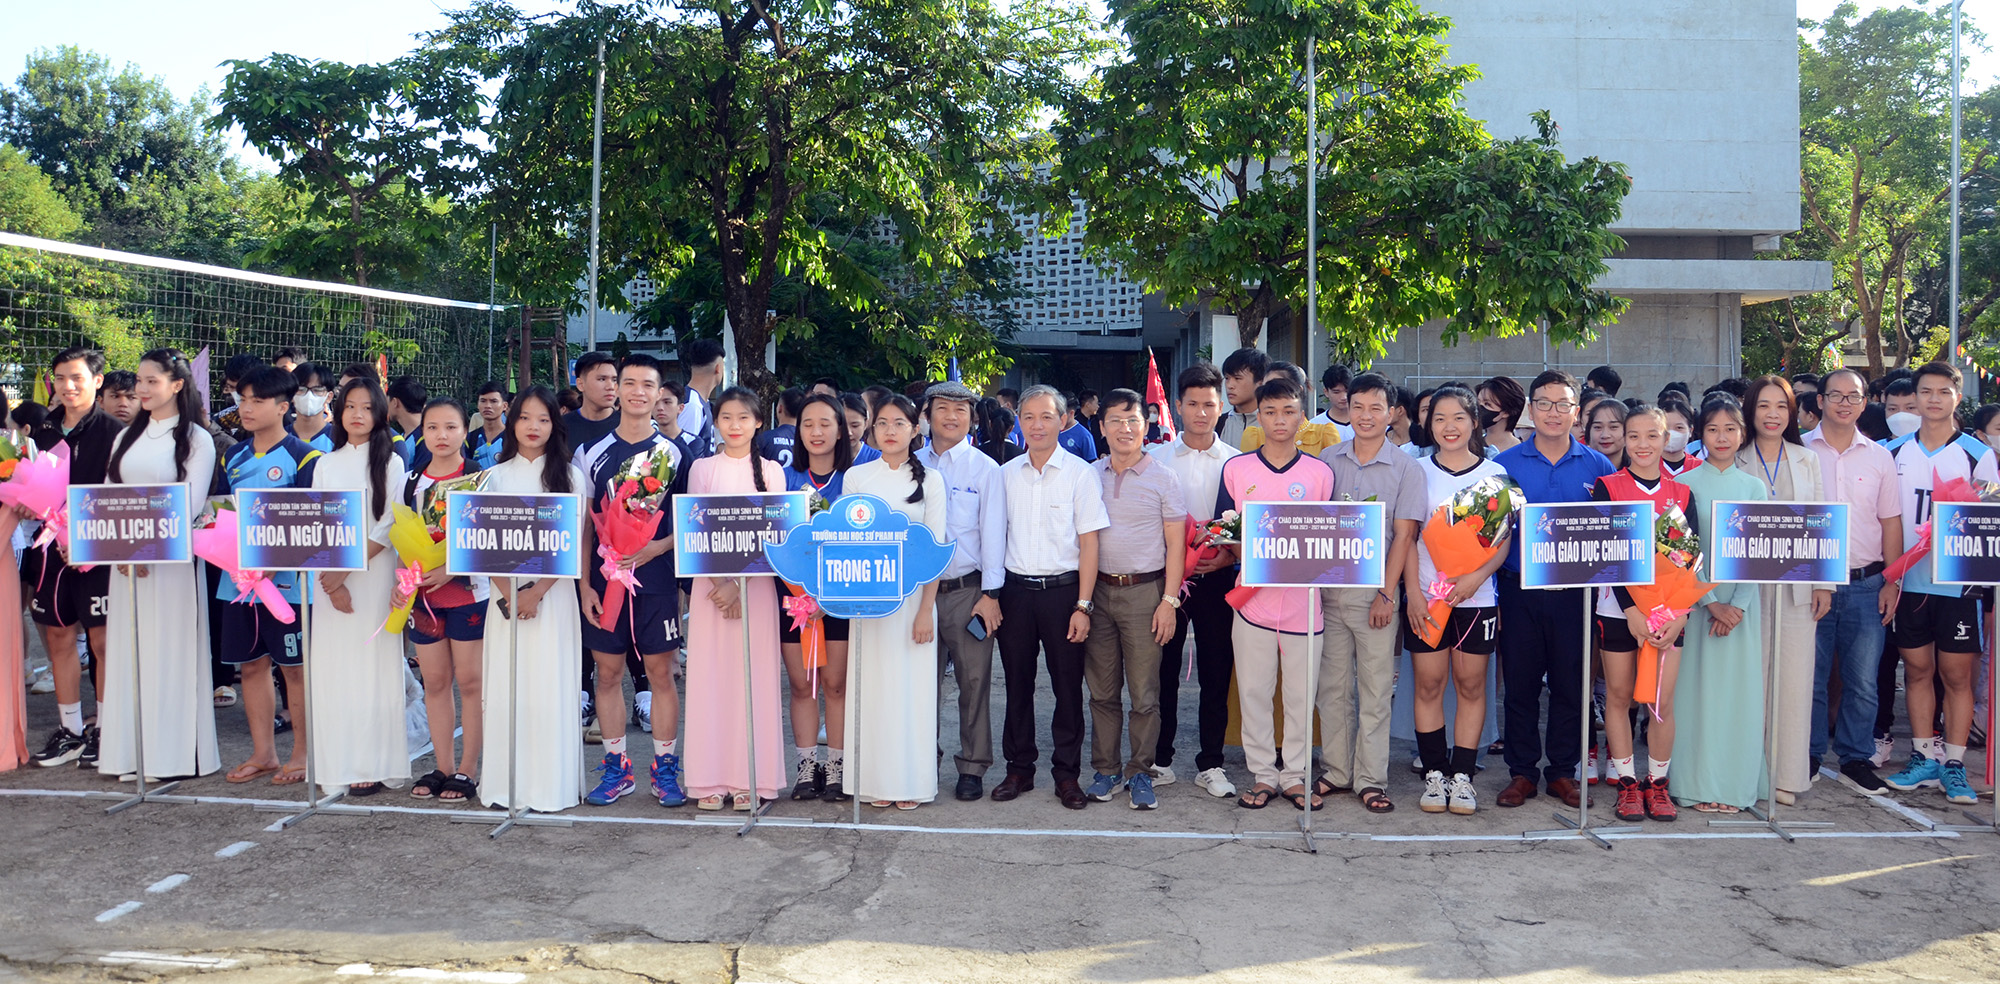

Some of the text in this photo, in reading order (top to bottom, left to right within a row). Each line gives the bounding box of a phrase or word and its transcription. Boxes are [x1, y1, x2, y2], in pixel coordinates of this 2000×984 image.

[77, 511, 180, 544] KHOA LỊCH SỬ
[246, 521, 356, 546] KHOA NGỮ VĂN
[456, 525, 570, 556] KHOA HOÁ HỌC
[895, 529, 909, 541] HUẾ
[684, 532, 710, 552] KHOA
[712, 527, 733, 552] GIÁO
[736, 531, 755, 557] DỤC
[1253, 537, 1374, 564] KHOA TIN HỌC
[1532, 535, 1645, 566] KHOA GIÁO DỤC CHÍNH TRỊ
[1722, 531, 1840, 563] KHOA GIÁO DỤC MẦM NON
[1944, 536, 1983, 557] KHOA
[826, 555, 896, 587] TRỌNG TÀI
[91, 596, 108, 615] 20
[664, 618, 678, 641] 14
[1483, 616, 1496, 640] 17
